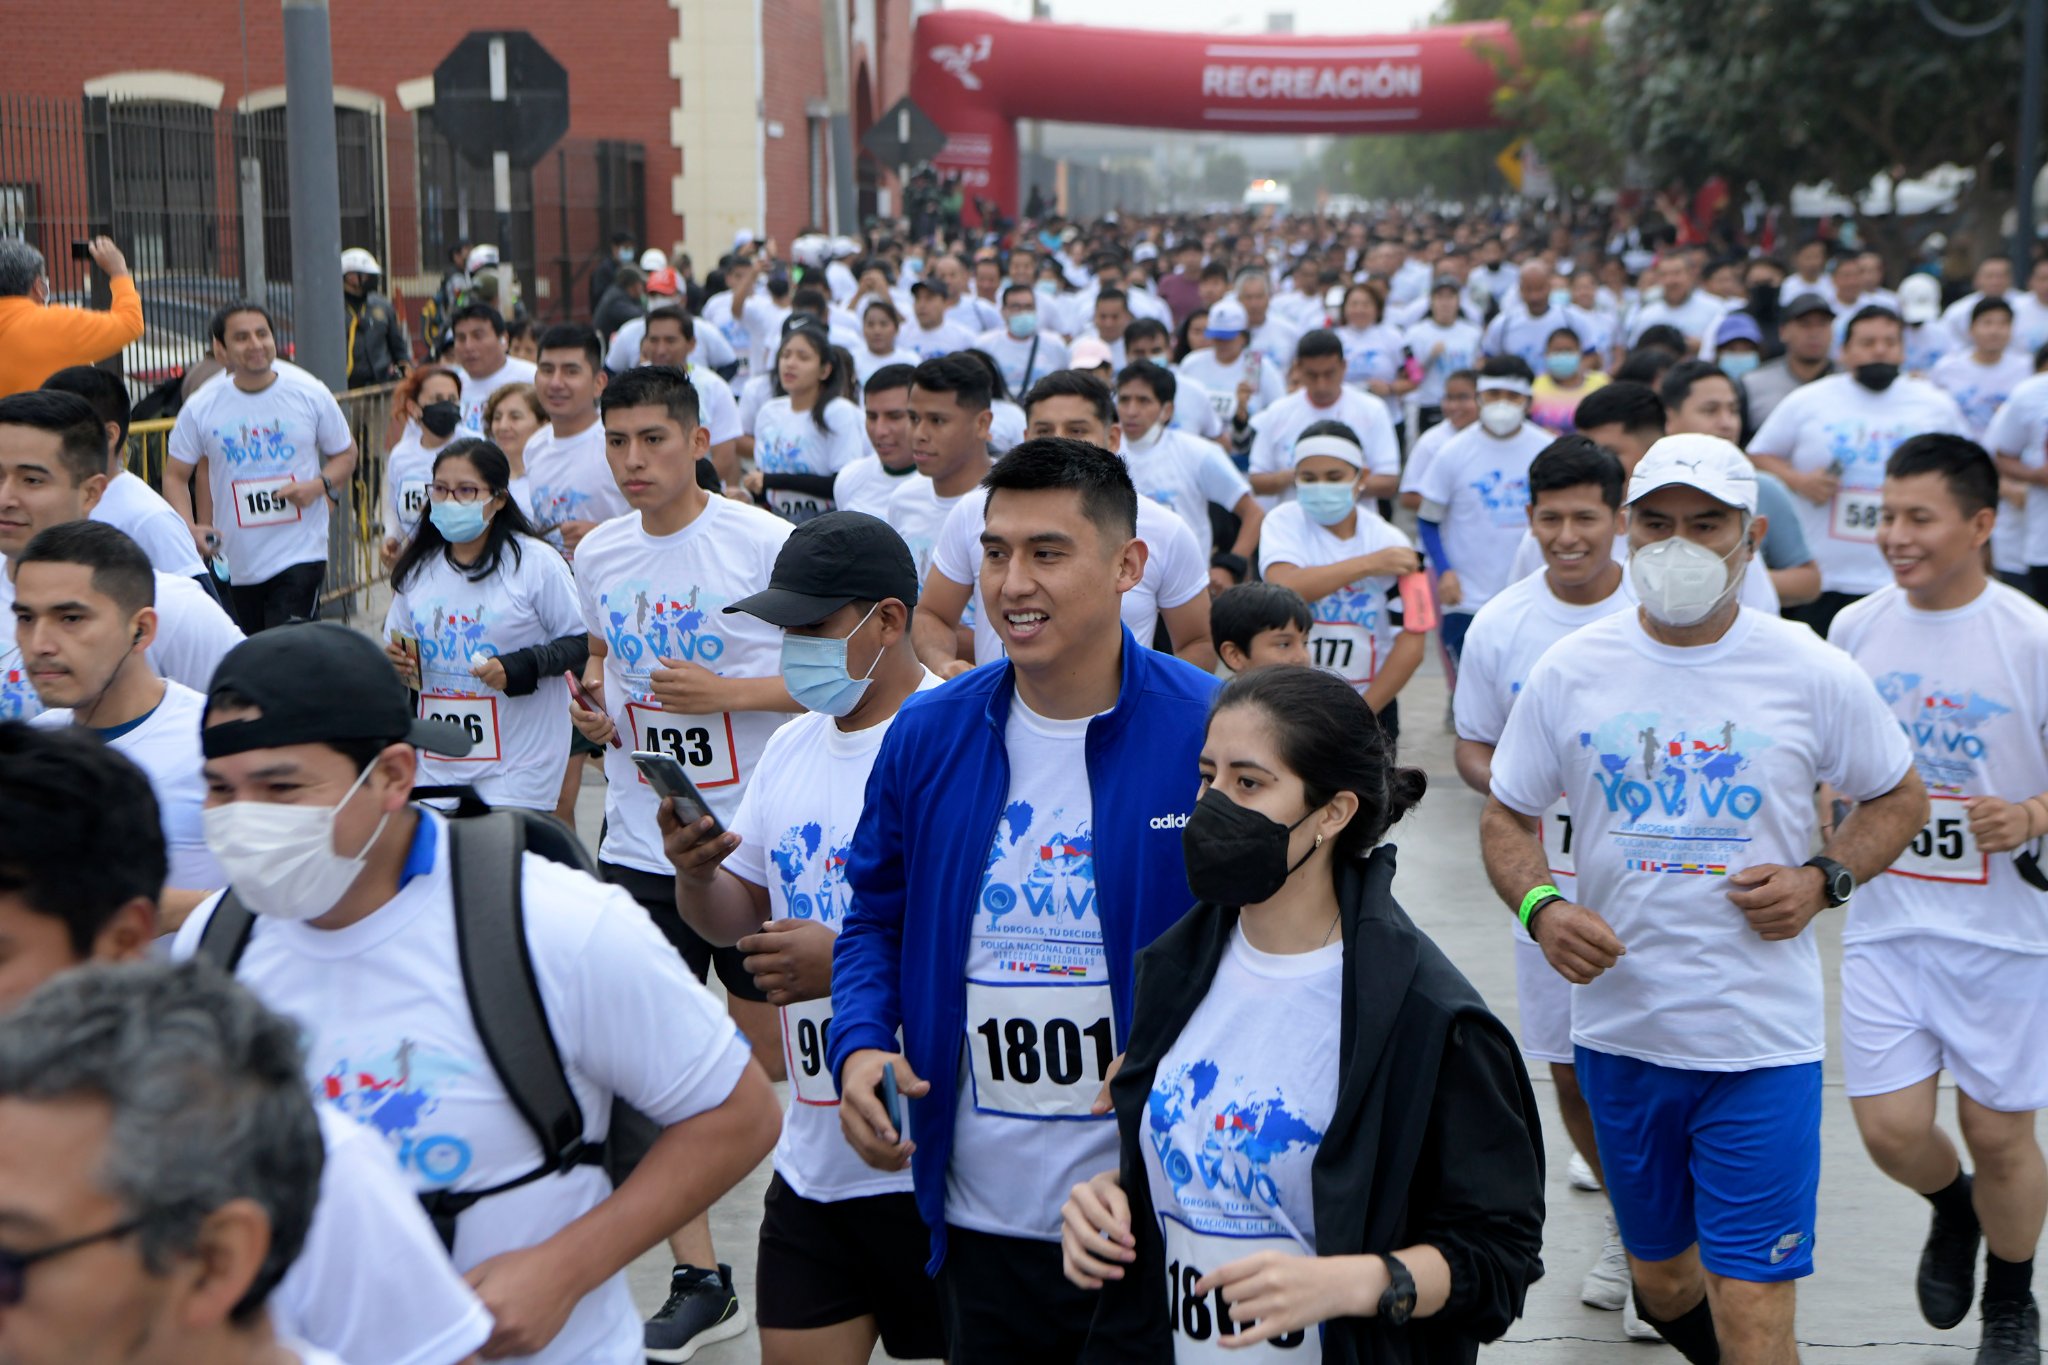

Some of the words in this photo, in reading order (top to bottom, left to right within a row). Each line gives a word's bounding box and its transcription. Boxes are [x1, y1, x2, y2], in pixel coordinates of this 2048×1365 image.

[1203, 61, 1421, 98] RECREACIÓN
[245, 490, 286, 515] 169
[1846, 503, 1879, 530] 58
[1312, 637, 1353, 667] 177
[646, 726, 713, 767] 433
[1149, 812, 1191, 829] adid
[986, 924, 1001, 933] SIN
[1049, 927, 1060, 937] TÚ
[1062, 929, 1103, 939] DECIDES
[980, 938, 1015, 949] POLICÍA
[1016, 942, 1063, 954] NACIONAL
[1065, 945, 1081, 955] DEL
[993, 950, 1039, 962] DIRECCIÓN
[1041, 953, 1095, 966] ANTIDROGAS
[798, 1018, 834, 1077] 9
[977, 1017, 1114, 1086] 1801
[1195, 1217, 1242, 1231] NACIONAL
[1245, 1222, 1264, 1232] DEL
